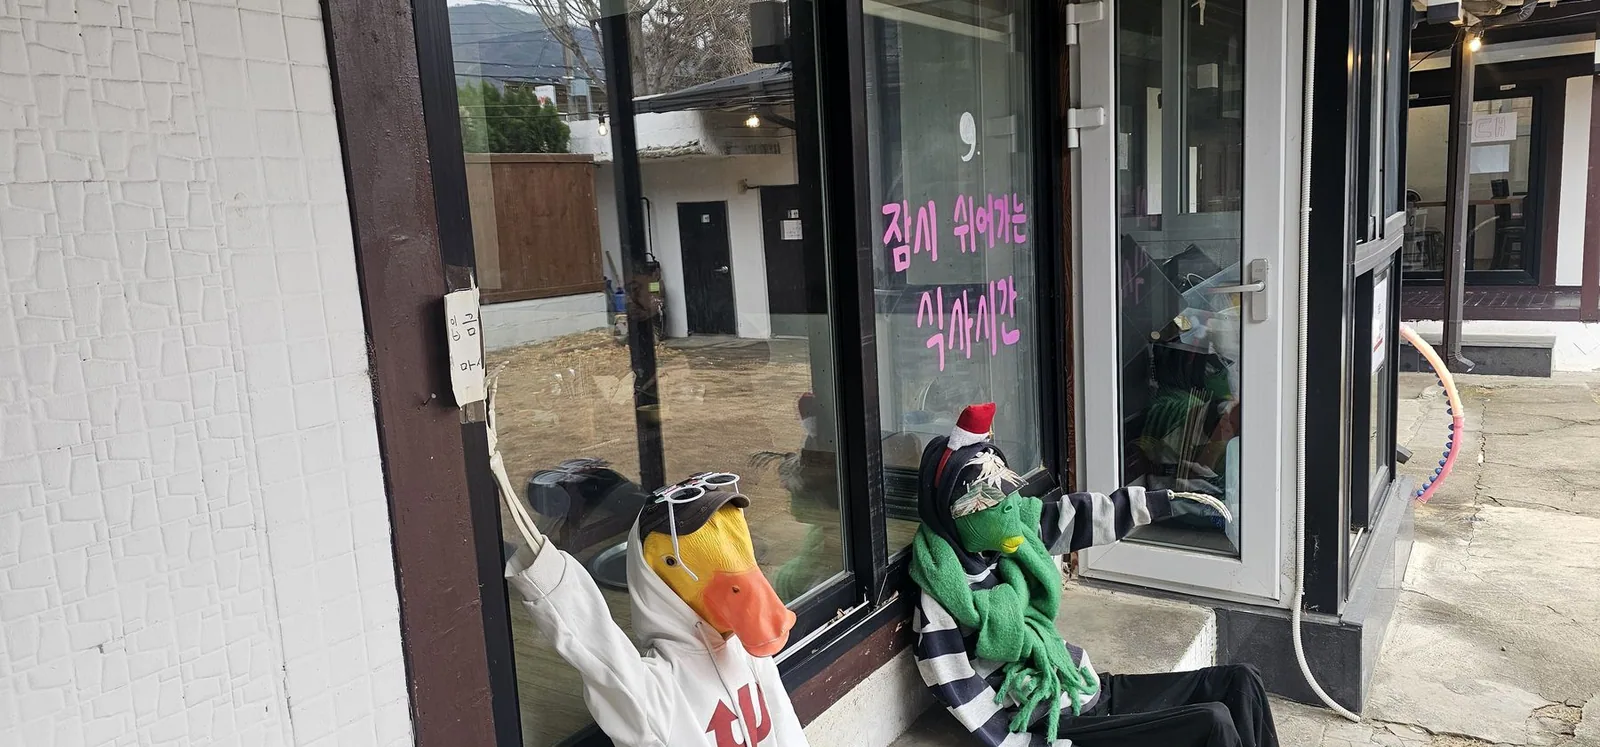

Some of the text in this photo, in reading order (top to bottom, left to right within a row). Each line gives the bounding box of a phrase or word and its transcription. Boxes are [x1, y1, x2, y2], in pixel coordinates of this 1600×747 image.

[882, 193, 1026, 272] 잠시 쉬어가는
[917, 276, 1020, 371] 식사시간
